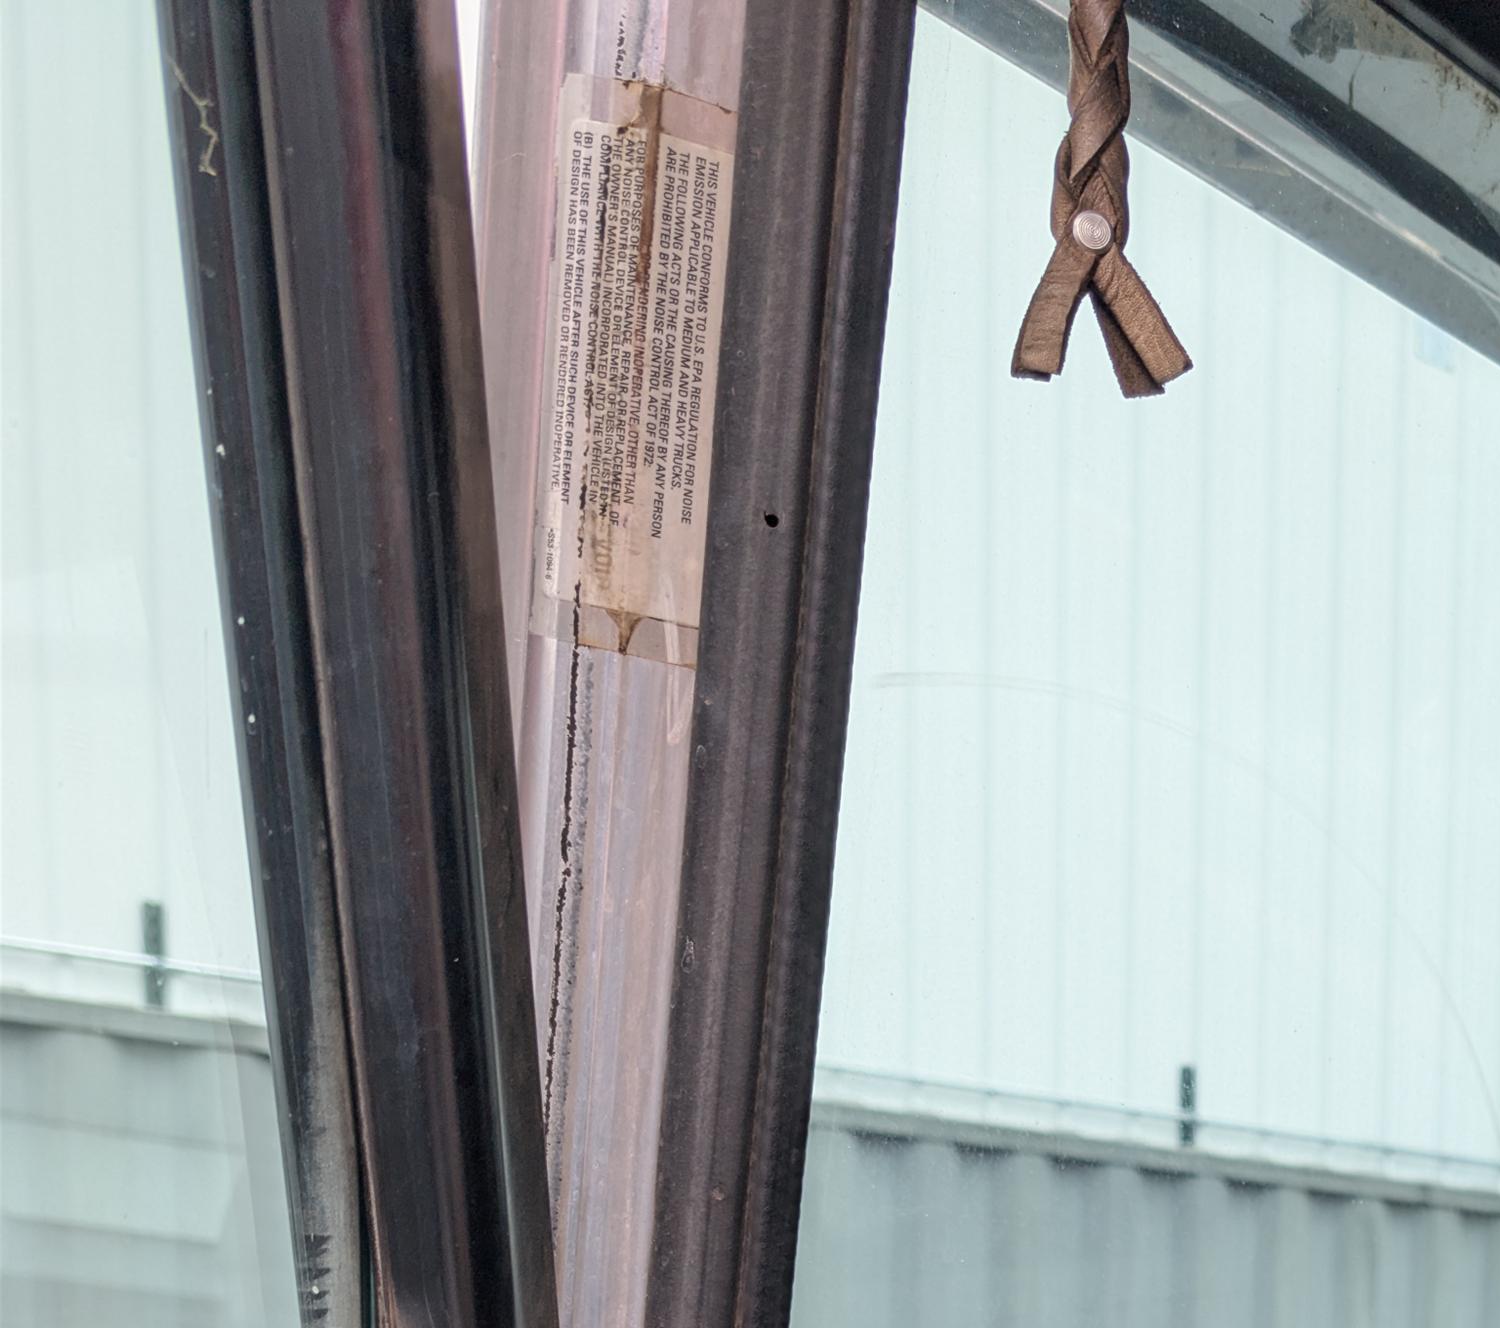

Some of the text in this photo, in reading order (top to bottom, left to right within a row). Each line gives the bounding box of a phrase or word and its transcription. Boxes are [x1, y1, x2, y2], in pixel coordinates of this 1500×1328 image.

[624, 138, 635, 164] ANY
[635, 139, 646, 163] FOR
[621, 167, 633, 206] NOISE
[630, 167, 644, 231] PURPOSES
[616, 209, 629, 265] CONTROL
[628, 235, 639, 250] OF
[550, 131, 583, 490] OF DESIGN HAS BEEN REMOVED OR RENDERED INOPERATIVE.
[588, 281, 601, 318] NOISE
[613, 269, 625, 311] DEVICE
[621, 253, 638, 346] MAINTENANCE,
[642, 146, 677, 466] ARE PROHIBITED BY THE NOISE CONTROL ACT OF 1972:
[560, 131, 593, 504] (B) THE USE OF THIS VEHICLE AFTER SUCH DEVICE OR ELEMENT
[588, 136, 624, 503] THE OWNER'S MANUAL) INCORPORATED INTO THE VEHICLE IN
[611, 315, 621, 330] OR
[670, 156, 706, 490] EMISSION APPLICABLE TO MEDIUM AND HEAVY TRUCKS.
[607, 334, 620, 388] ELEMENT
[650, 152, 690, 538] THE FOLLOWING ACTS OR THE CAUSING THEREOF BY ANY PERSON
[680, 161, 719, 524] THIS VEHICLE CONFORMS TO U.S. EPA REGULATION FOR NOISE
[617, 350, 630, 395] REPAIR,
[628, 345, 645, 427] INOPERATIVE,
[606, 392, 615, 409] OF
[615, 399, 627, 416] OR
[602, 414, 614, 454] DESIGN
[625, 430, 638, 468] OTHER
[599, 457, 611, 501] (LISTED
[608, 419, 625, 508] REPLACEMENT,
[622, 471, 635, 504] THAN
